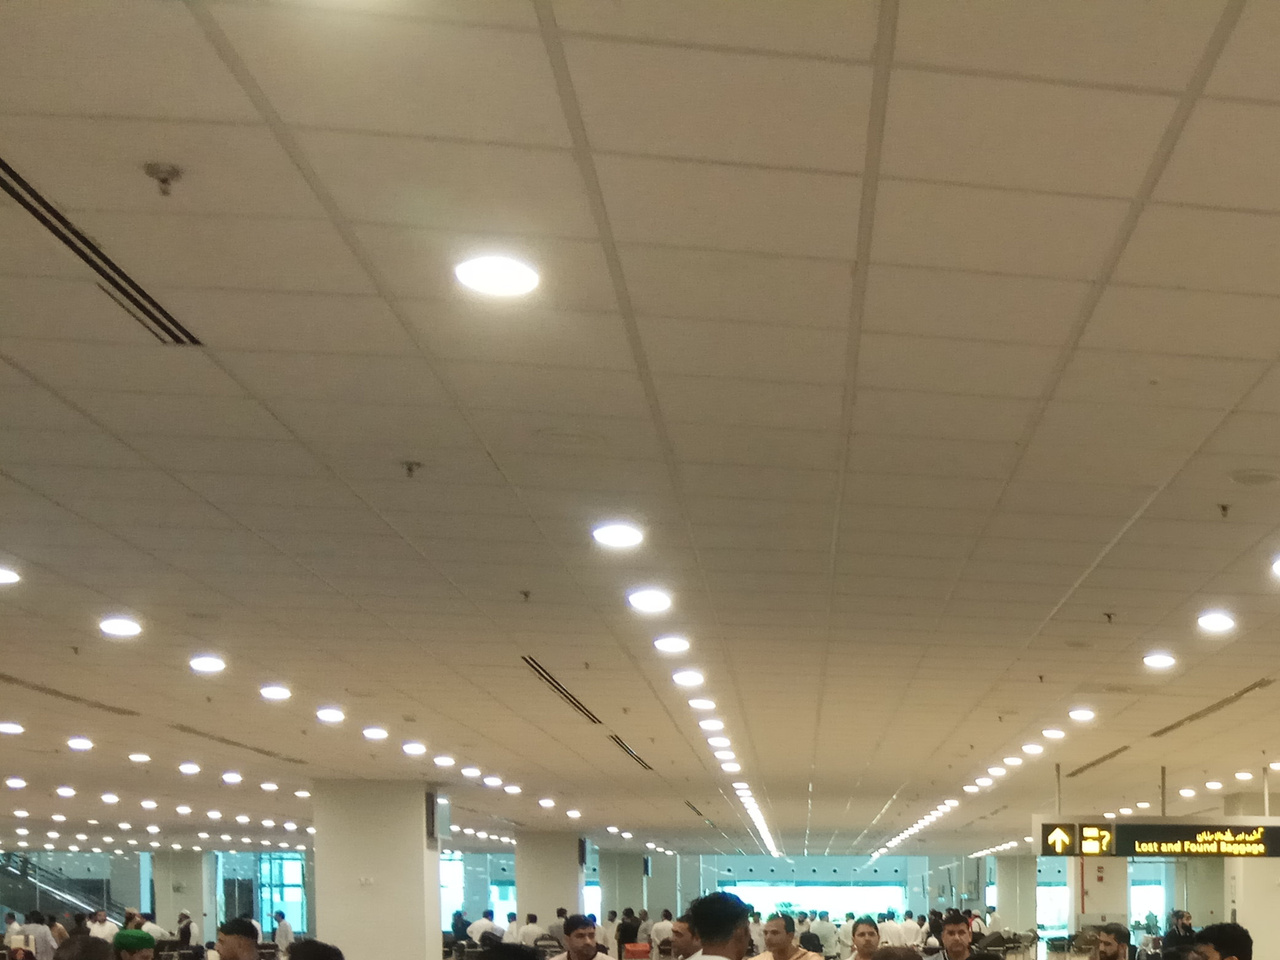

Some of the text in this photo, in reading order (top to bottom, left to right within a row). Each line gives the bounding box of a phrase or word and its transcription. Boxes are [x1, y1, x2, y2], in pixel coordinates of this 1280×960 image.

[1134, 841, 1265, 855] Lost and Found Baggage
